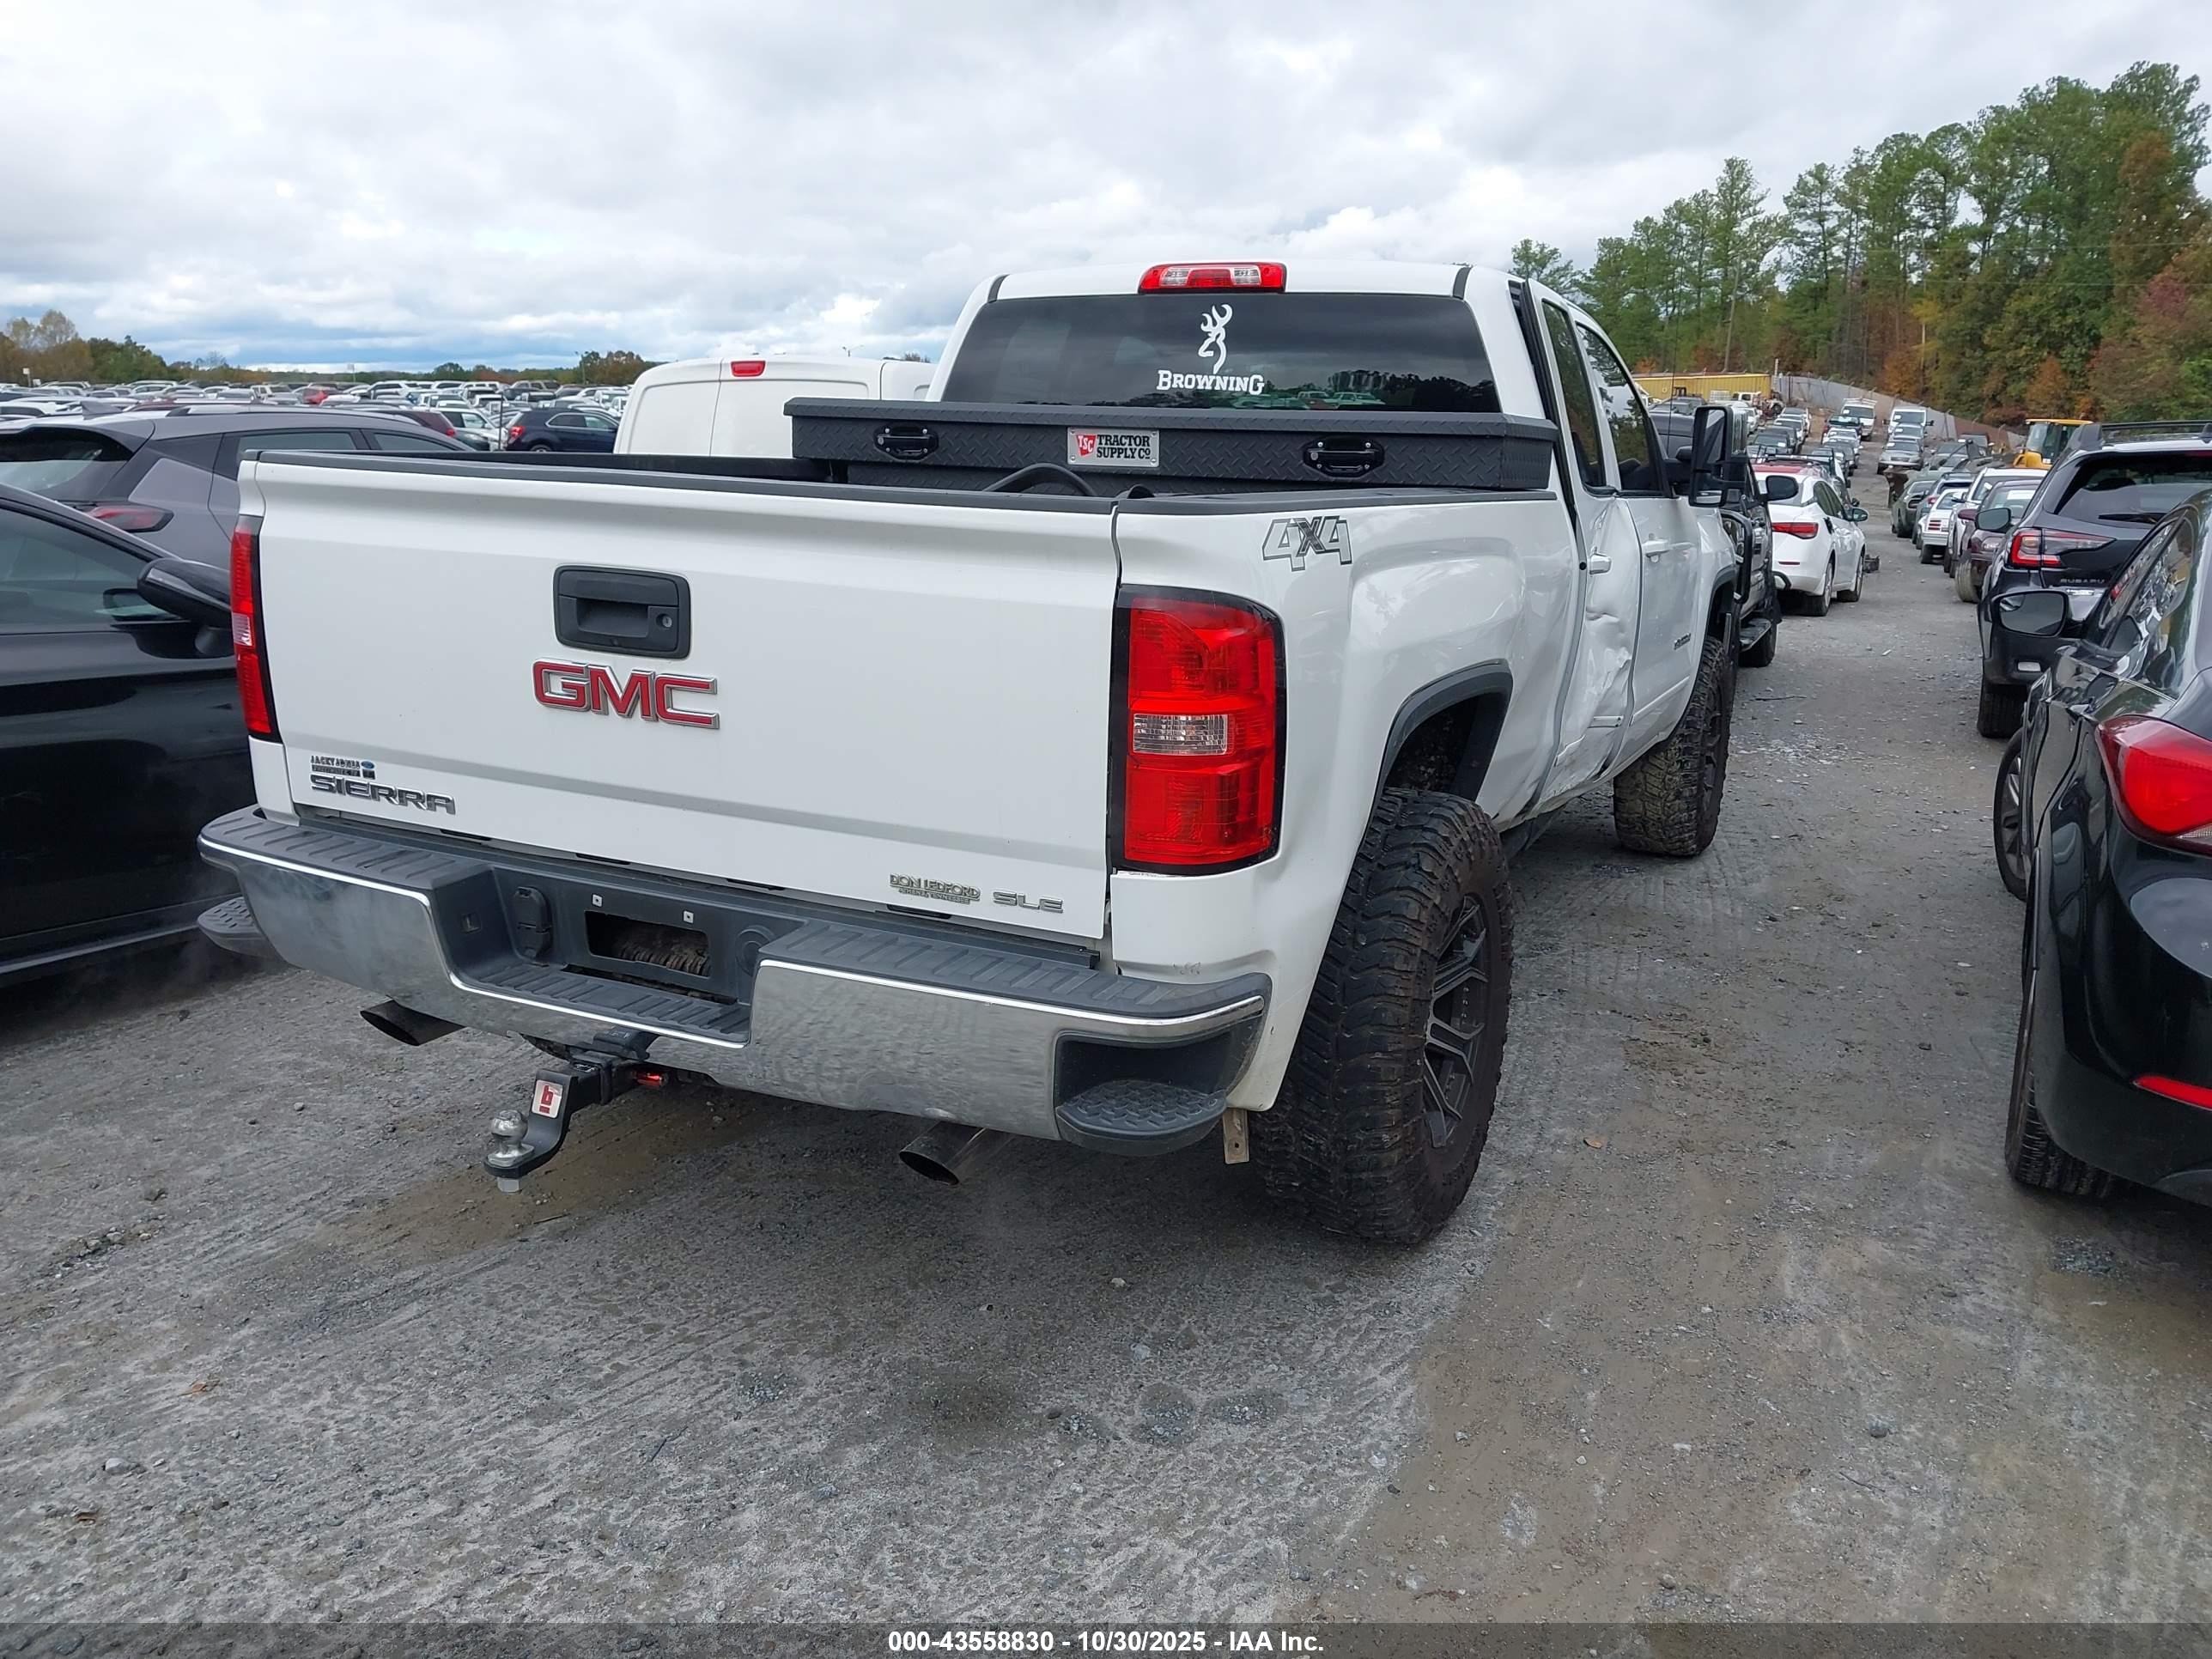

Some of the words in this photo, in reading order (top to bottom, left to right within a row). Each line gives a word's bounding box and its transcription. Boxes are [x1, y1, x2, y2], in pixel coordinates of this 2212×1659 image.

[1157, 369, 1265, 395] BROWNING
[1077, 434, 1094, 453] TSC
[1097, 434, 1151, 447] TRACTOR
[1097, 447, 1138, 459] SUPPLY
[532, 657, 720, 730] GMC
[310, 774, 456, 815] SIERRA
[890, 873, 921, 889] DON
[924, 878, 981, 898] LEDFORD
[992, 888, 1064, 914] SLE
